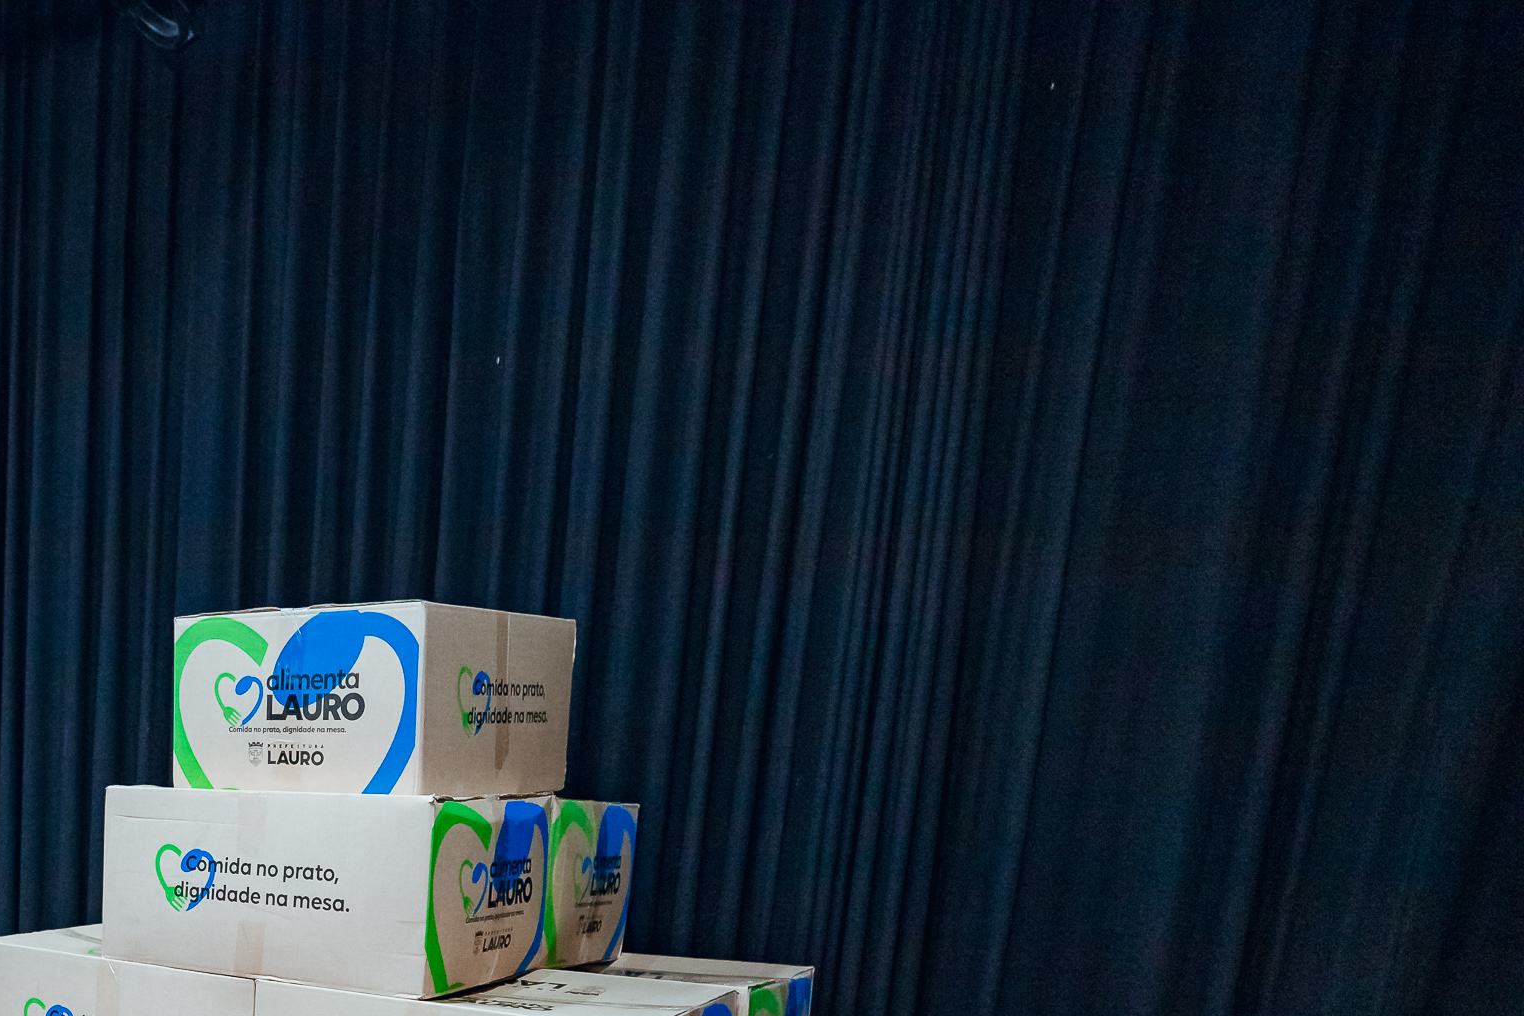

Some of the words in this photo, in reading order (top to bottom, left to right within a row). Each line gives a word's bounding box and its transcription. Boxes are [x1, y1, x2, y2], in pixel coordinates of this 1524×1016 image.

[266, 668, 360, 691] alimenta
[474, 678, 509, 697] Comida
[510, 683, 522, 697] no
[521, 682, 546, 701] prato,
[266, 692, 366, 721] LAURO
[467, 706, 513, 730] dignidade
[513, 711, 525, 724] na
[525, 711, 549, 724] mesa.
[262, 726, 282, 734] prato,
[282, 726, 316, 734] dignidade
[267, 750, 324, 766] LAURO
[186, 855, 252, 876] Comida
[256, 863, 279, 878] no
[282, 865, 339, 885] prato,
[490, 855, 532, 878] alimenta
[173, 880, 262, 905] dignidade
[265, 892, 289, 907] na
[293, 895, 350, 913] mesa.
[488, 876, 533, 909] LAURO
[482, 934, 512, 952] LAURO
